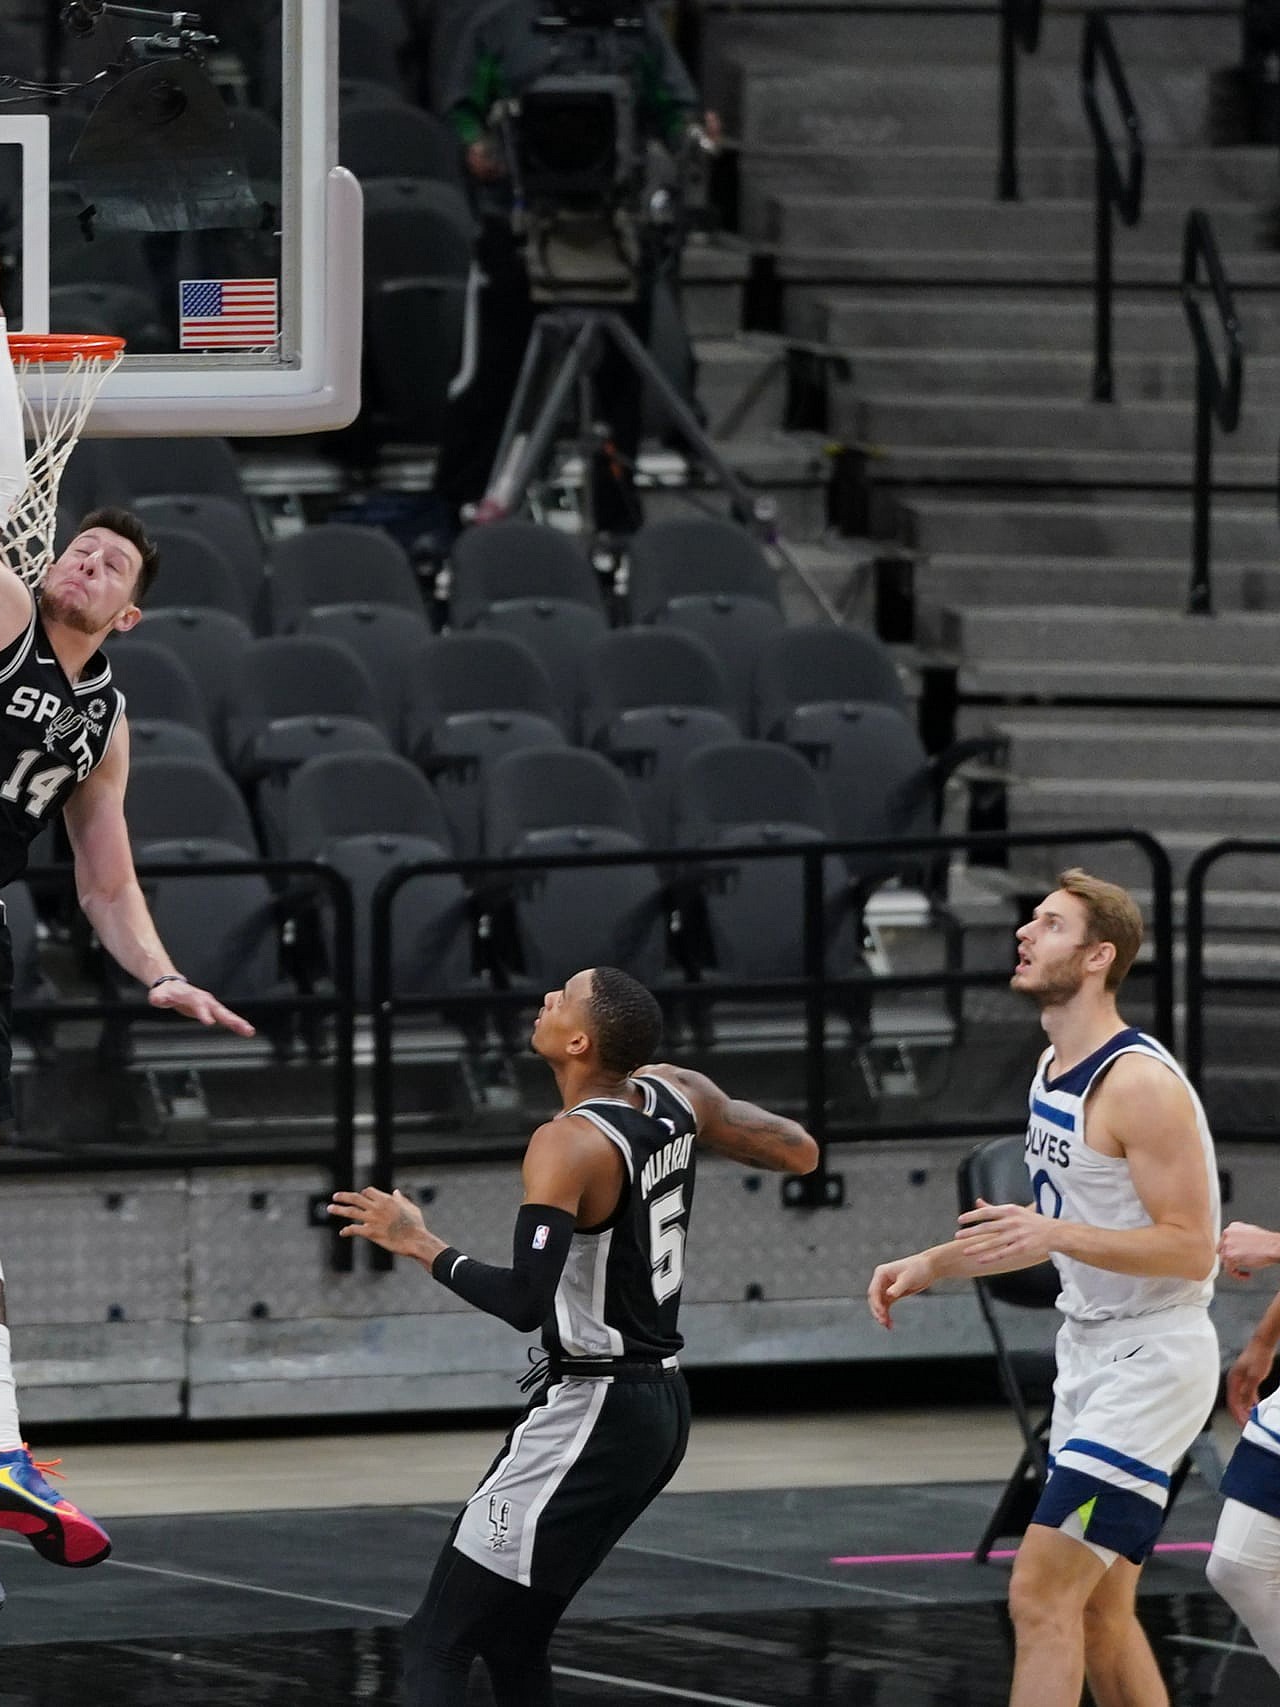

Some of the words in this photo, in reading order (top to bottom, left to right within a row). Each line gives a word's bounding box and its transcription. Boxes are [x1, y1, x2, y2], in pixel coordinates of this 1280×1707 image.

[0, 749, 76, 819] 14
[640, 1132, 696, 1200] MURRAY
[649, 1183, 686, 1306] 5
